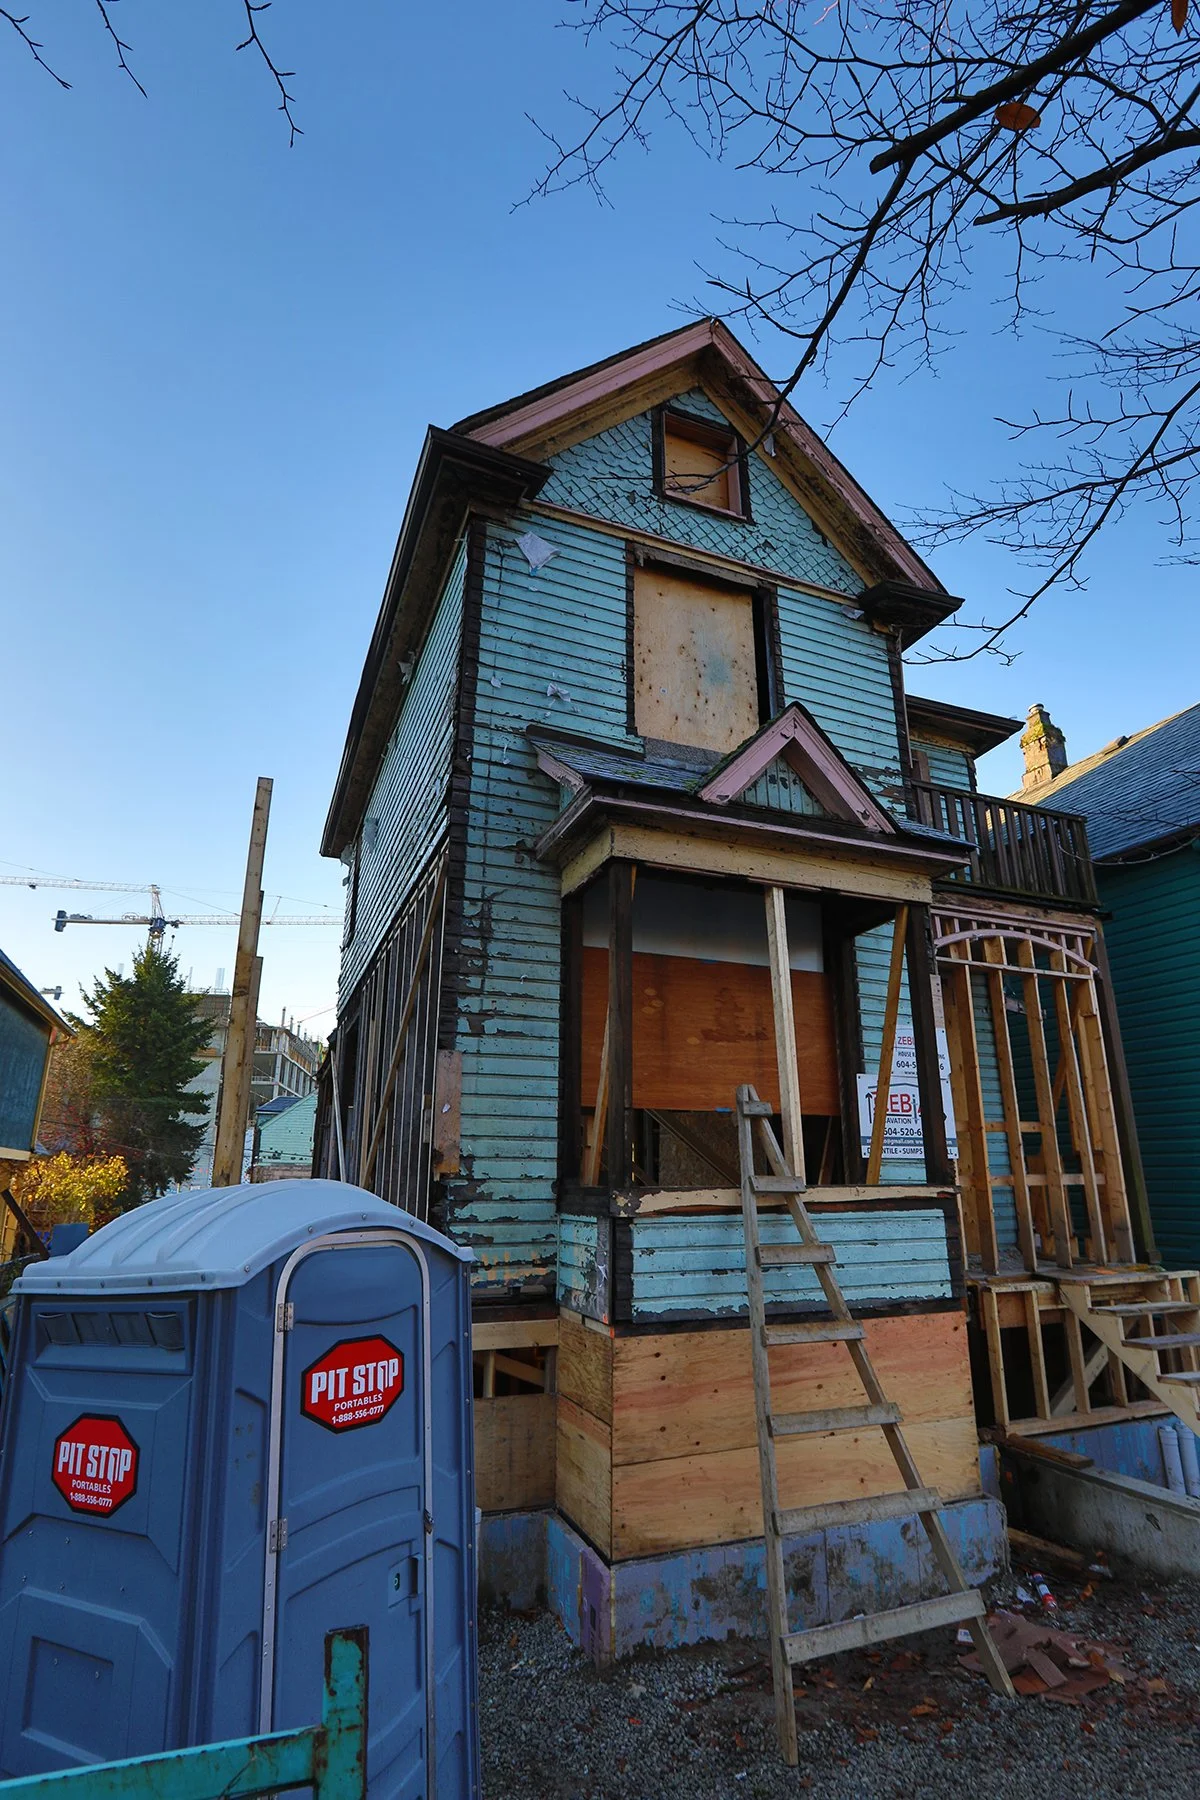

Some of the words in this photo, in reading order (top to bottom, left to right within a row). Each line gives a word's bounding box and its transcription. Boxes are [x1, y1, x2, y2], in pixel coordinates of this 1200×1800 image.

[897, 1036, 914, 1046] ZEB
[896, 1060, 917, 1069] 604-5
[886, 1117, 912, 1125] AVATION
[884, 1127, 923, 1136] 604-520-6
[310, 1368, 349, 1404] PIT
[352, 1358, 399, 1395] STOP
[334, 1393, 383, 1411] PORTABLES
[331, 1405, 385, 1424] 1-888-556-0777
[57, 1441, 86, 1476] PIT
[86, 1445, 132, 1485] STOP
[71, 1479, 112, 1494] PORTABLES
[70, 1492, 113, 1508] 1-888-556-0777
